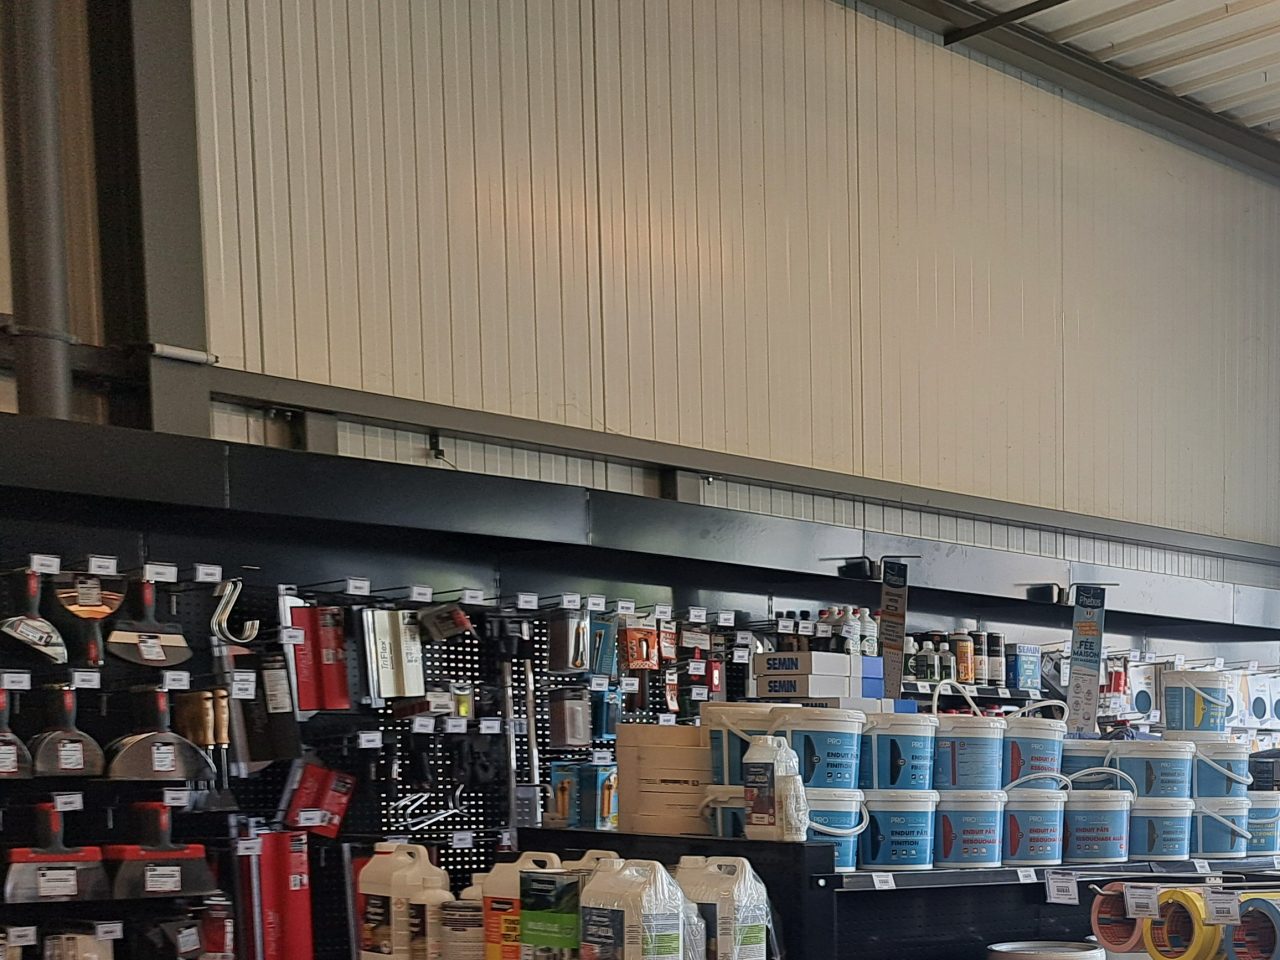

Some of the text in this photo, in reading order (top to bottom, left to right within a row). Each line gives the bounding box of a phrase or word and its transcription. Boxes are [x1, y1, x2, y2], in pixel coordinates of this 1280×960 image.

[1016, 645, 1040, 655] SEMIN
[1073, 650, 1100, 659] MAISON
[766, 657, 799, 671] SEMIN
[767, 679, 797, 693] SEMIN
